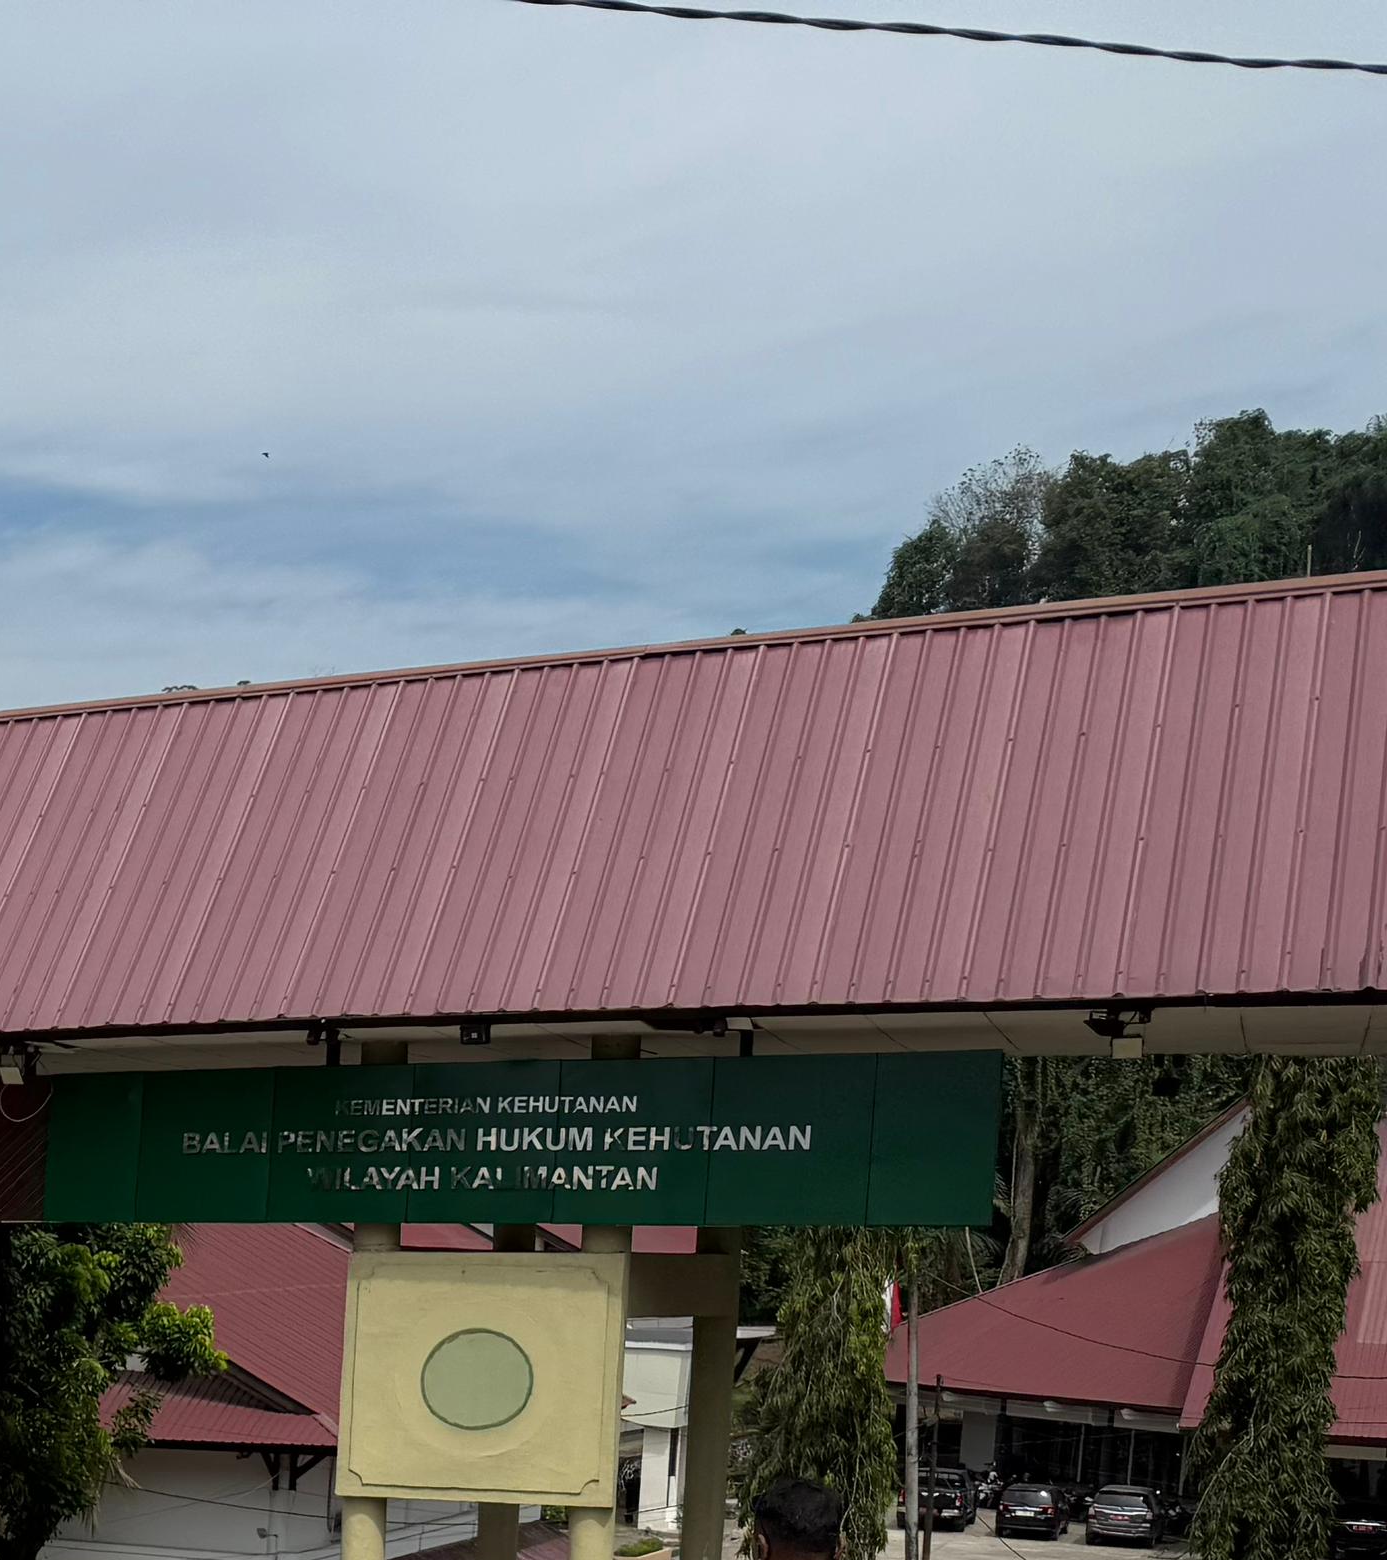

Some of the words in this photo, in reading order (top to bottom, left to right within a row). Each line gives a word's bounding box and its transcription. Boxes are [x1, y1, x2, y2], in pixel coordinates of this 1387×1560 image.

[334, 1096, 491, 1116] KEMENTERIAN
[497, 1095, 638, 1114] KEHUTANAN
[182, 1131, 268, 1154] BALAI
[277, 1127, 466, 1153] PENEGAKAN
[477, 1126, 594, 1152] HUKUM
[603, 1125, 813, 1151] KEHUTANAN
